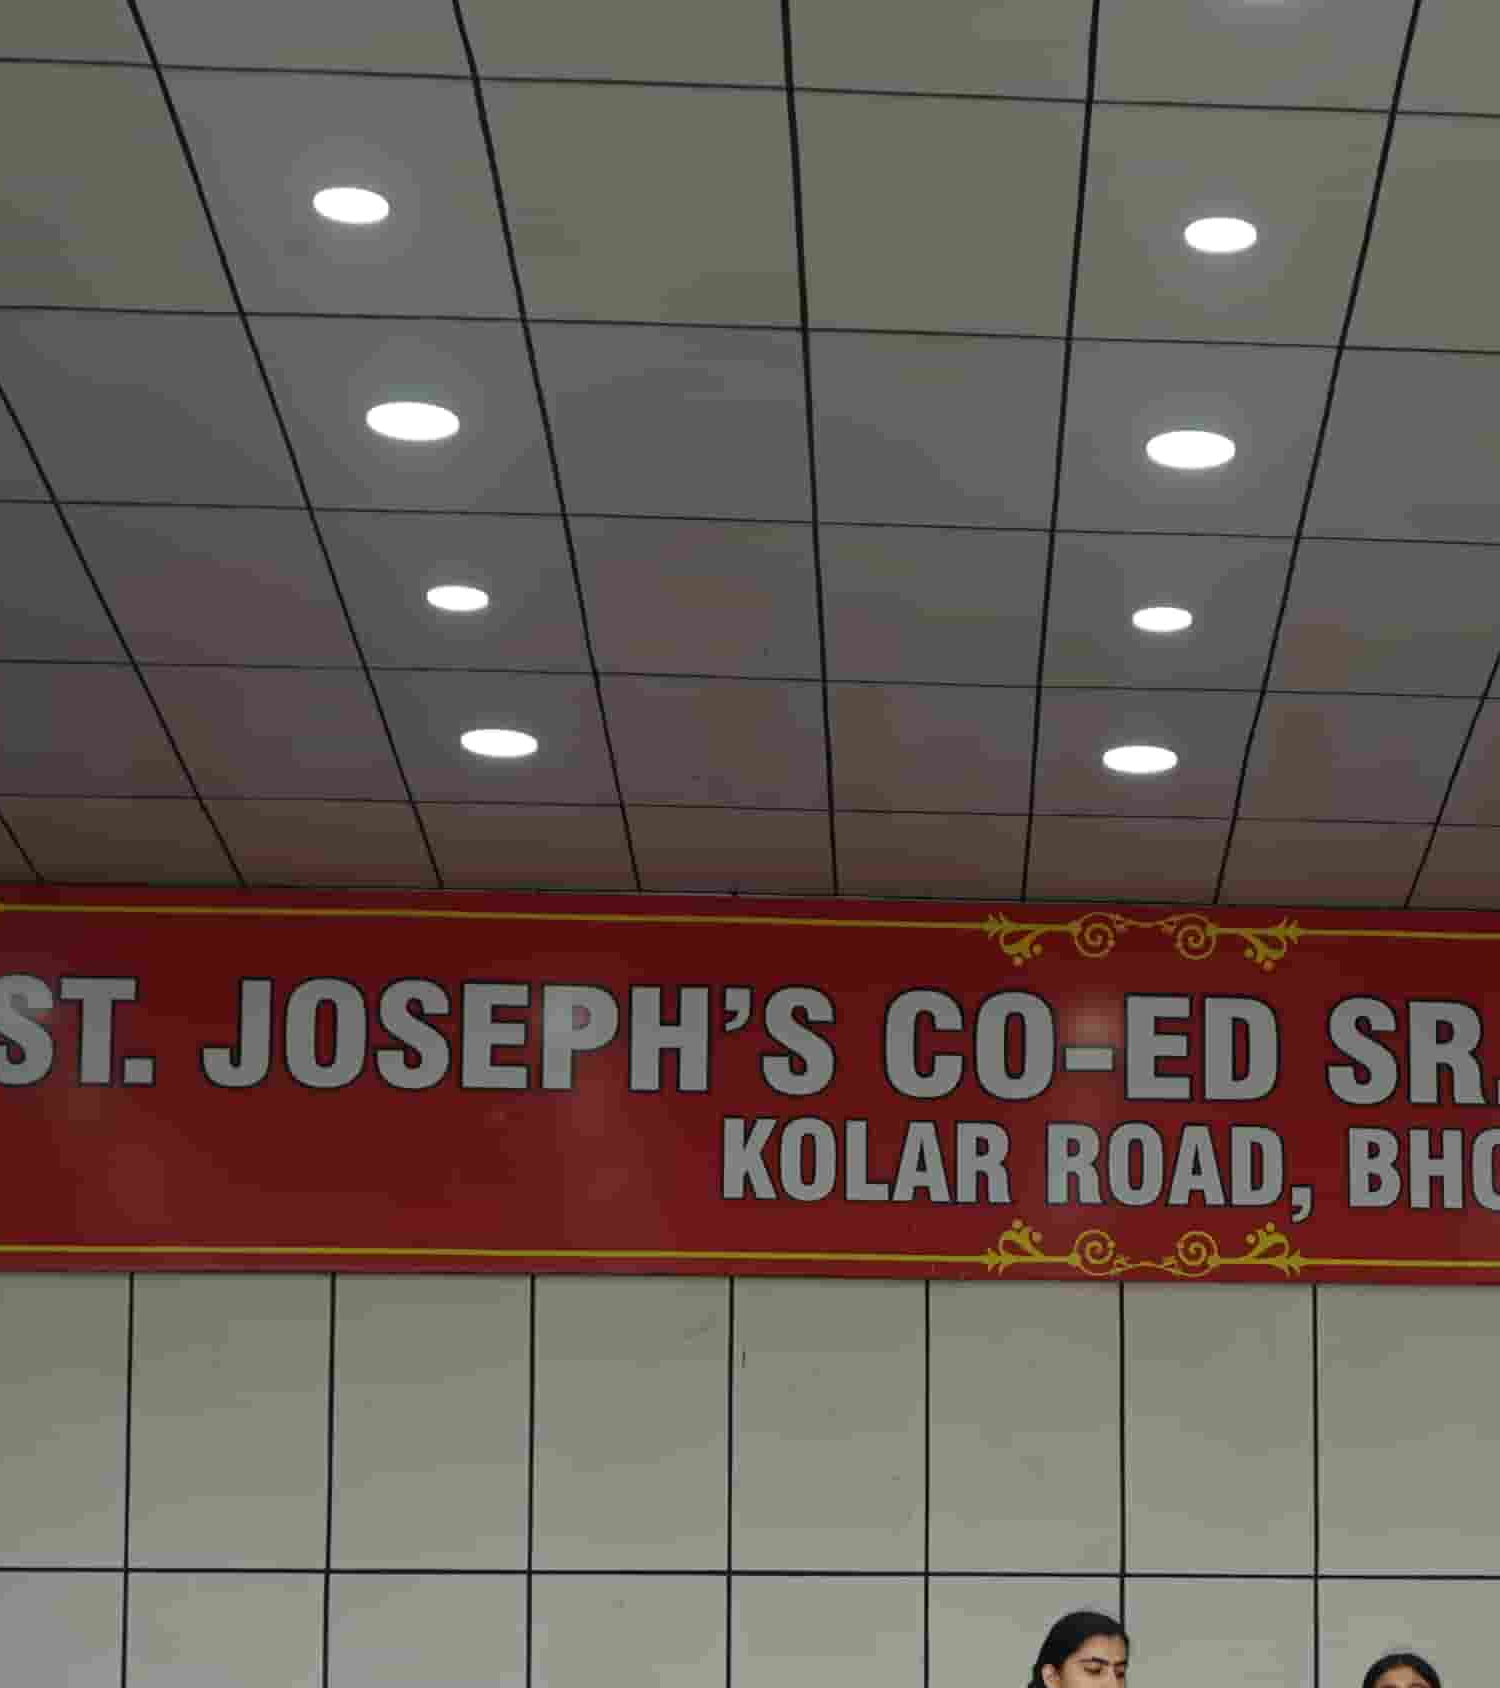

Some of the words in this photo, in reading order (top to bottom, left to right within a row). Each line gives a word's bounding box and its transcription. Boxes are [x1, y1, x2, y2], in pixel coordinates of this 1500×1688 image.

[201, 977, 836, 1097] JOSEPH'S
[883, 988, 1279, 1102] CO-ED
[721, 1115, 1014, 1206] KOLAR
[1045, 1121, 1314, 1225] ROAD,
